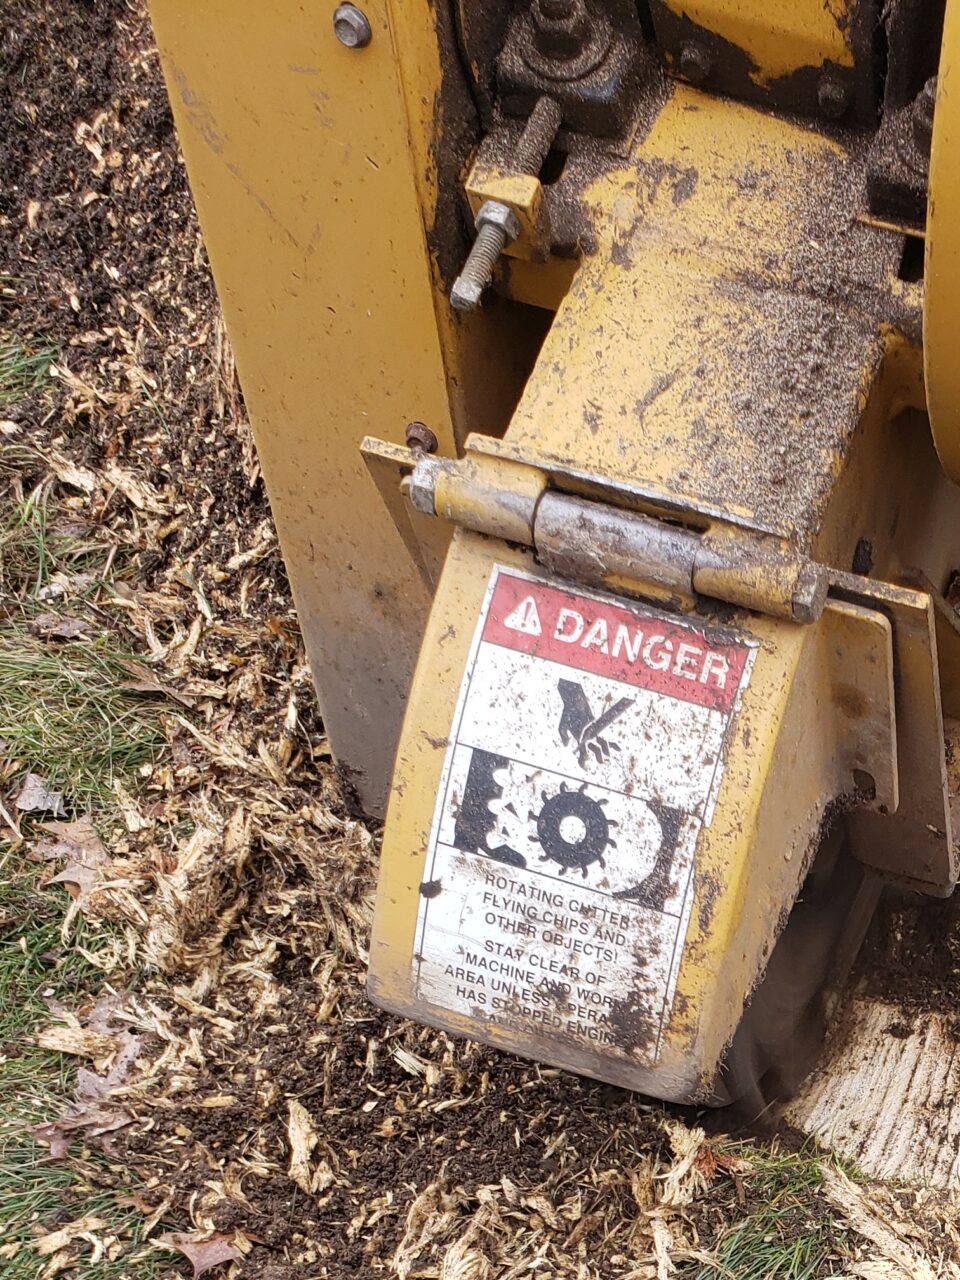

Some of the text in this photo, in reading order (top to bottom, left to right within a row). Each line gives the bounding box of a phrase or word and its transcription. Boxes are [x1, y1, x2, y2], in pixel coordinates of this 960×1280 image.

[553, 608, 730, 688] DANGER
[485, 874, 564, 907] ROTATING
[483, 891, 626, 946] FLYING CHIPS AND
[485, 912, 618, 964] OTHER OBJECTS!
[444, 964, 486, 987] AREA
[491, 978, 550, 1007] UNLESS
[465, 953, 620, 1011] MACHINE AND WOR
[484, 939, 606, 986] STAY CLEAR OF
[456, 985, 487, 1004] HAS
[491, 997, 562, 1028] STOPPED
[567, 1020, 620, 1046] ENGIN
